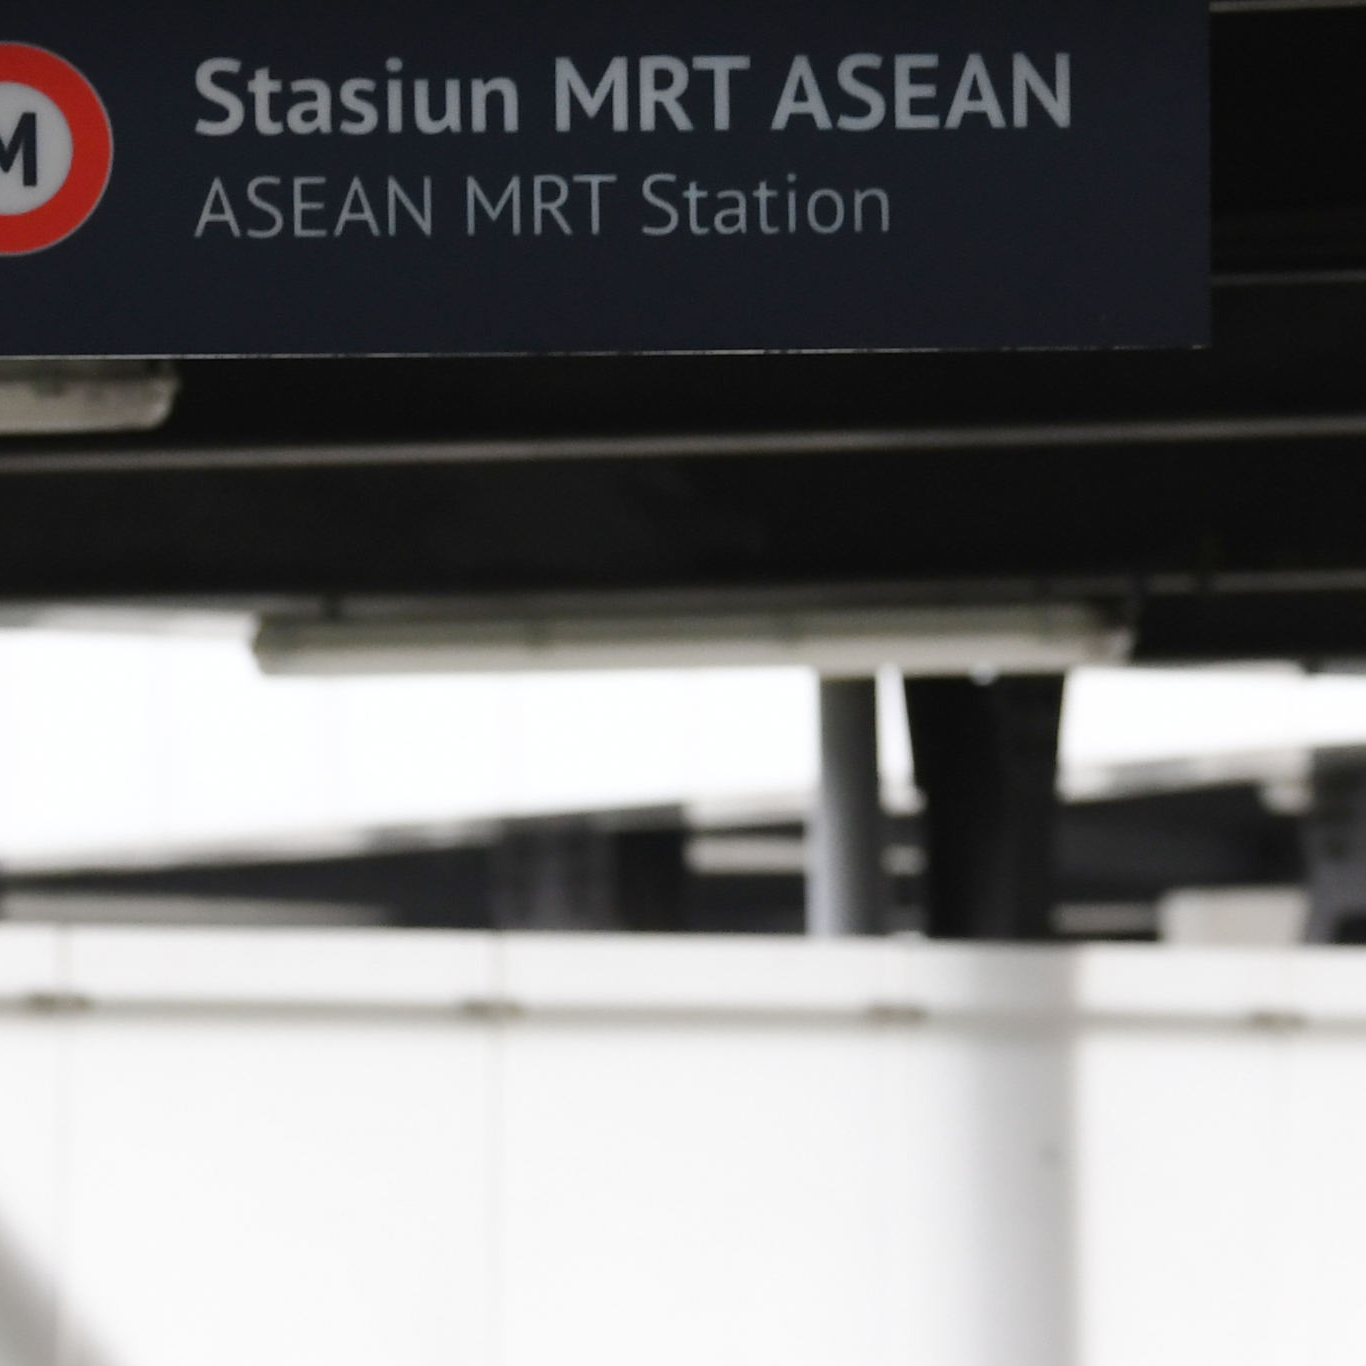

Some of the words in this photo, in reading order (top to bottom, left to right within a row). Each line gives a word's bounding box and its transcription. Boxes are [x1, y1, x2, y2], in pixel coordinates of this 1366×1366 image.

[195, 58, 519, 136] Stasiun
[555, 56, 749, 131] MRT
[771, 53, 1071, 130] ASEAN
[194, 176, 432, 239] ASEAN
[466, 174, 617, 235] MRT
[641, 172, 890, 236] Station
